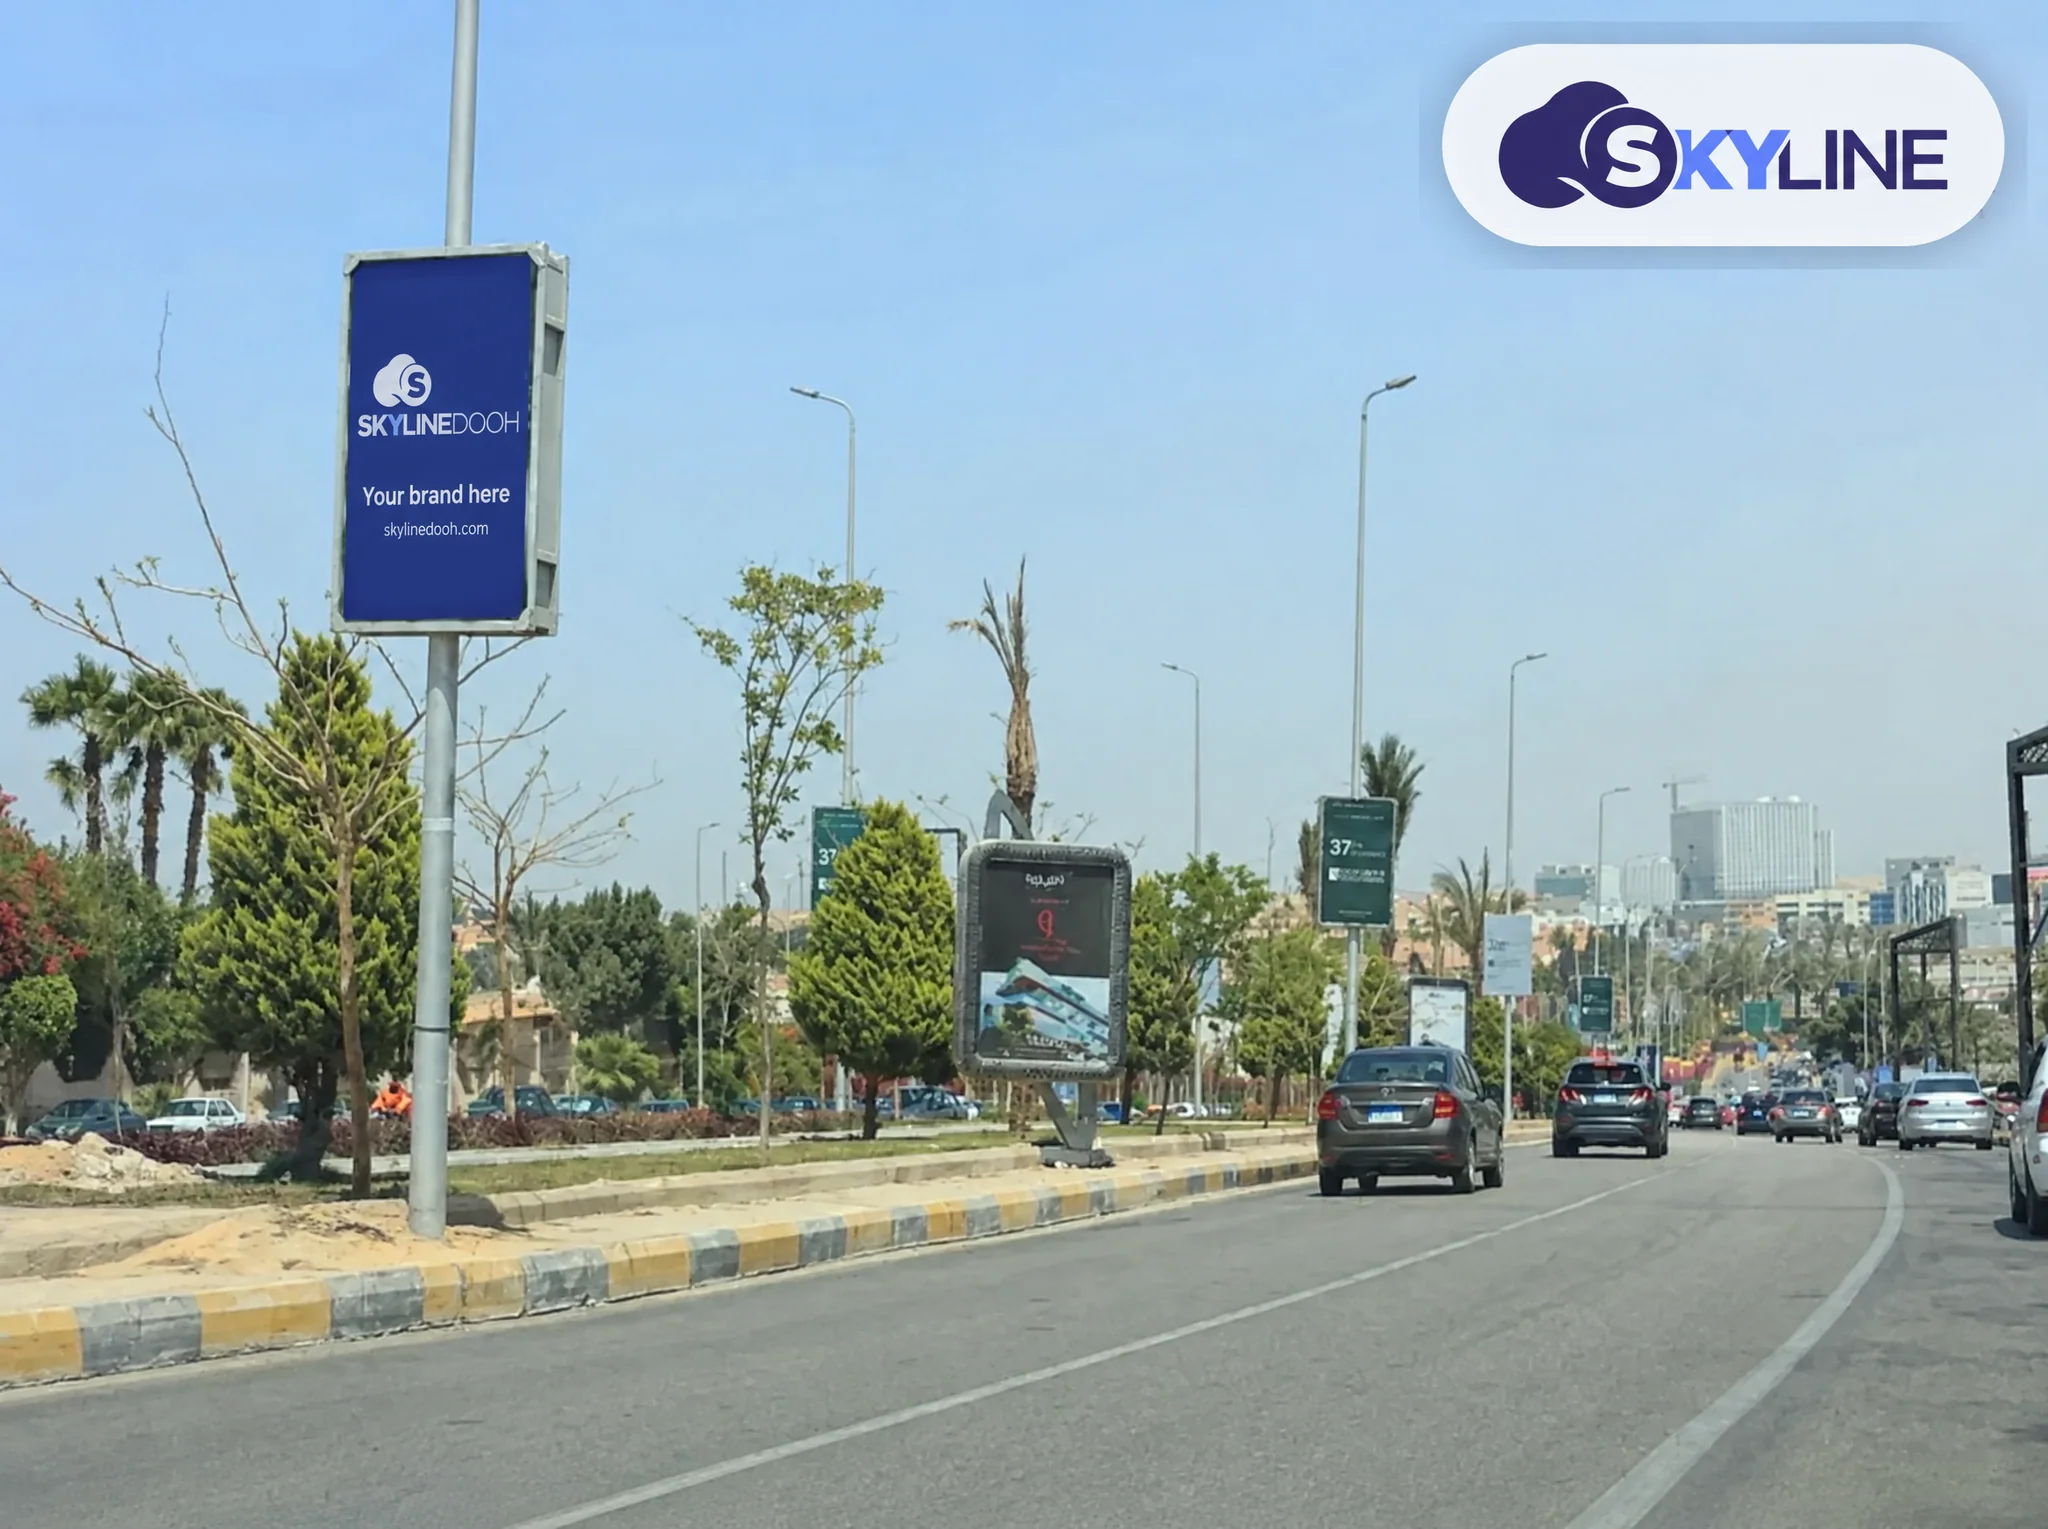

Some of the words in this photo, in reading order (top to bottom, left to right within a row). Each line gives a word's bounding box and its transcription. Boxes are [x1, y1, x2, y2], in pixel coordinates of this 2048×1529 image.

[407, 371, 426, 398] S
[357, 411, 519, 437] SKYLINEDOOH
[362, 487, 405, 506] Your
[409, 483, 463, 506] brand
[468, 483, 511, 504] here
[383, 521, 489, 540] skylinedooh.com
[1329, 838, 1352, 856] 37
